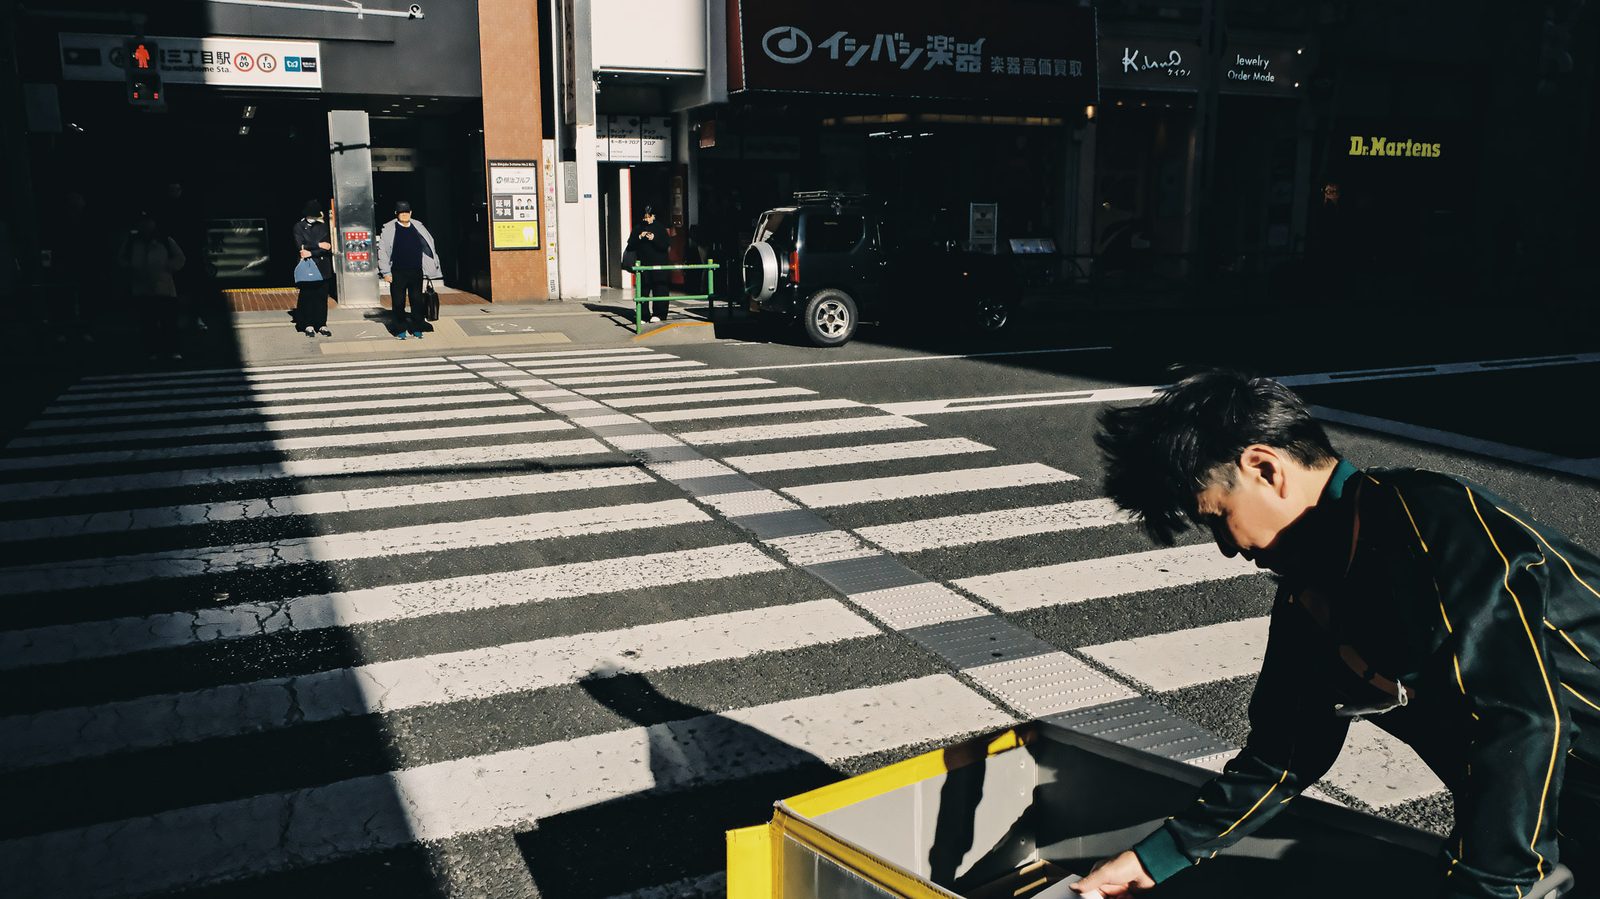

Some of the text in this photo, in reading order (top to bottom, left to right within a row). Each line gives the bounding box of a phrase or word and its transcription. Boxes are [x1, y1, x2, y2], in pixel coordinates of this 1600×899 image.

[160, 49, 231, 65] 三丁目駅
[817, 30, 986, 73] イシバシ楽器
[1236, 53, 1270, 70] Jewelry
[990, 55, 1083, 78] 楽器高価買取
[1227, 67, 1275, 83] Order Made
[1349, 135, 1441, 158] Dr.Martens
